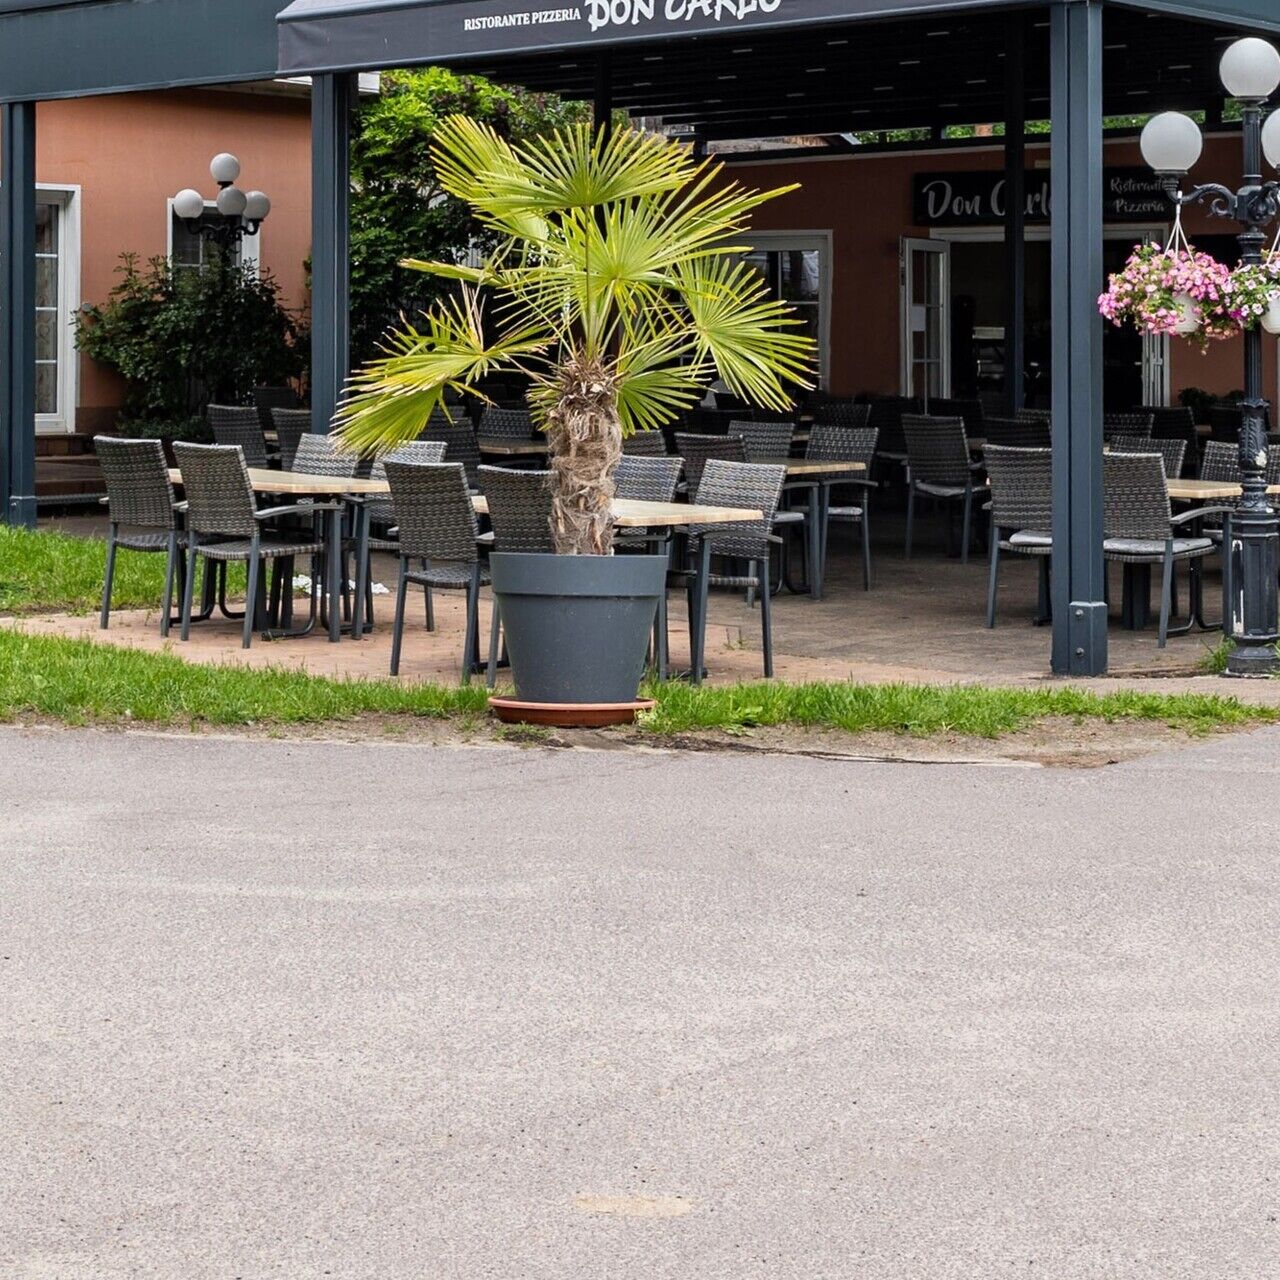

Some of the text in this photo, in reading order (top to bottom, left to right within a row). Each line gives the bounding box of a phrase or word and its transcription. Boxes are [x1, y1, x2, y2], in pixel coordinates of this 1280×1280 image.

[464, 13, 531, 31] RISTORANTE
[532, 8, 581, 25] PIZZERIA
[1110, 178, 1166, 194] Ristorant
[922, 179, 1051, 218] Don Crl
[1113, 198, 1165, 213] Pizzeria
